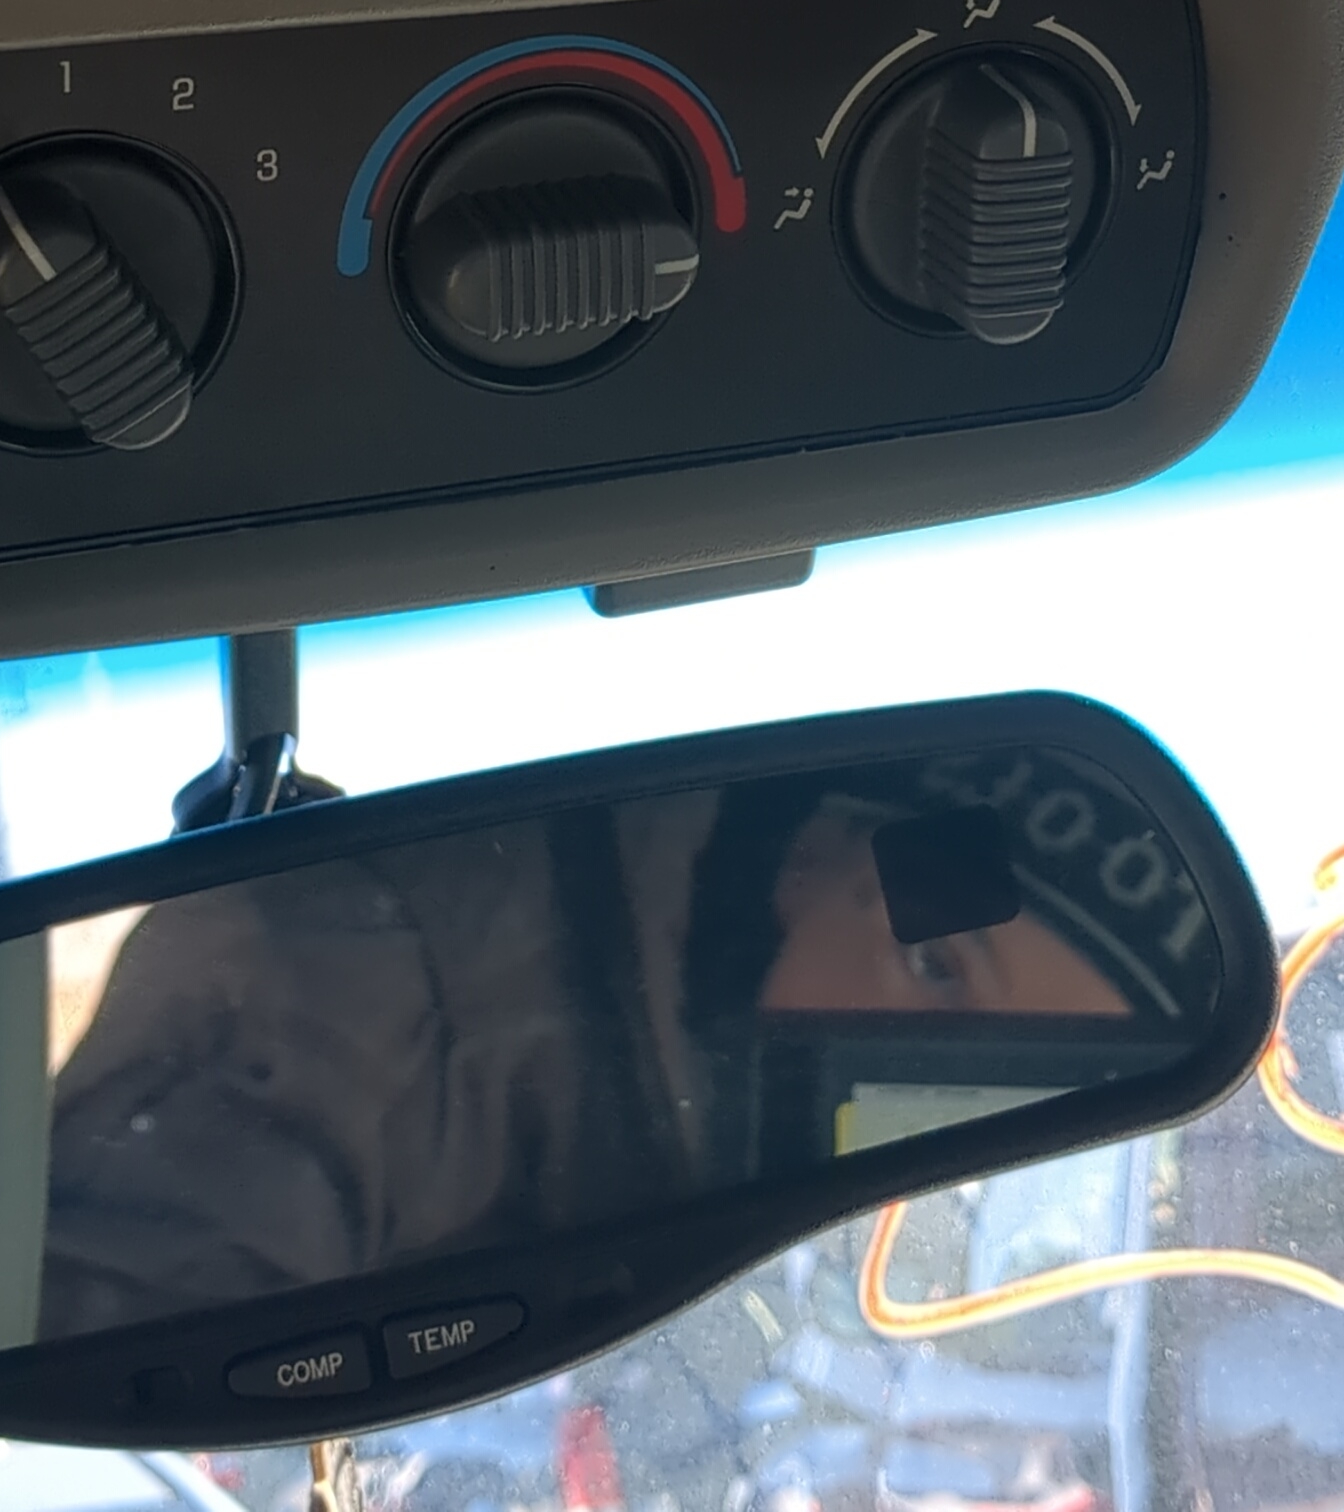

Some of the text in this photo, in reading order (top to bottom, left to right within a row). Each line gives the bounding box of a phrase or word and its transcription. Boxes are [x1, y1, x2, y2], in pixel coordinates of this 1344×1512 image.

[58, 60, 73, 94] 1
[171, 76, 196, 111] 2
[255, 148, 279, 181] 3
[407, 1319, 476, 1355] TEMP
[276, 1351, 344, 1388] COMP
